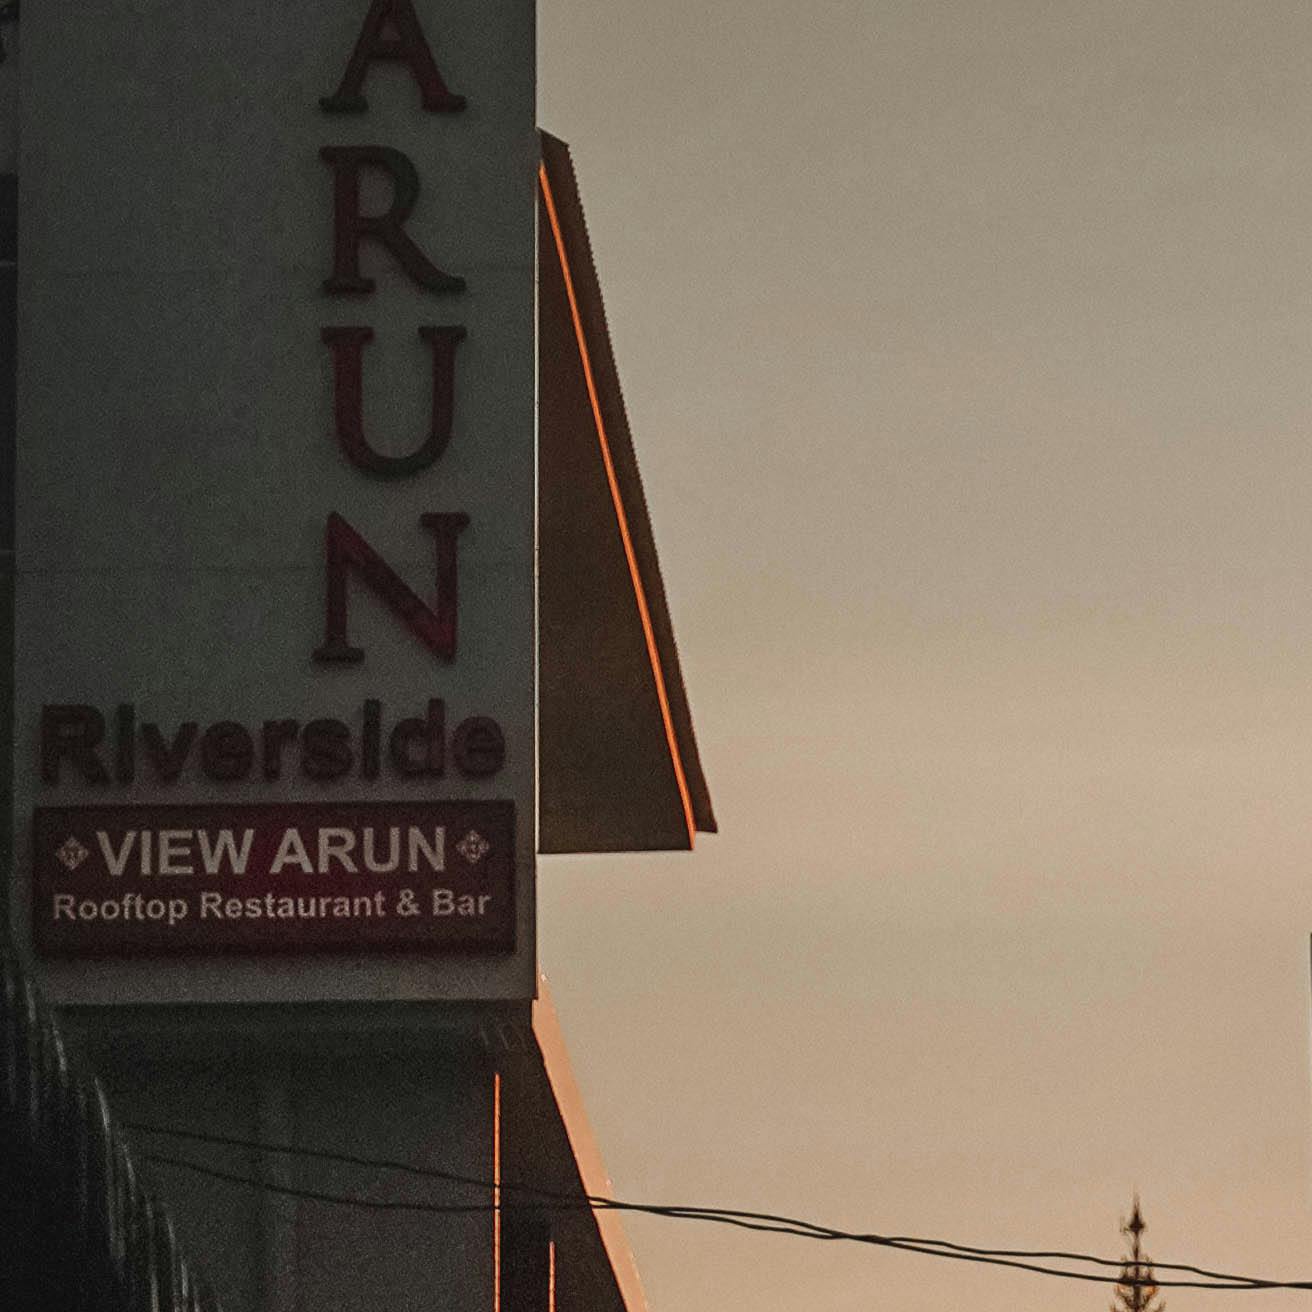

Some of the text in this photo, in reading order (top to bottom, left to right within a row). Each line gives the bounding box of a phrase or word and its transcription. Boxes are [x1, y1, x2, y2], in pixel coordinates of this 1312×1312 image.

[312, 0, 470, 665] ARUN
[39, 698, 507, 786] Riverside
[96, 826, 447, 877] VIEW ARUN
[52, 887, 491, 925] Rooftop Restaurant & Bar
